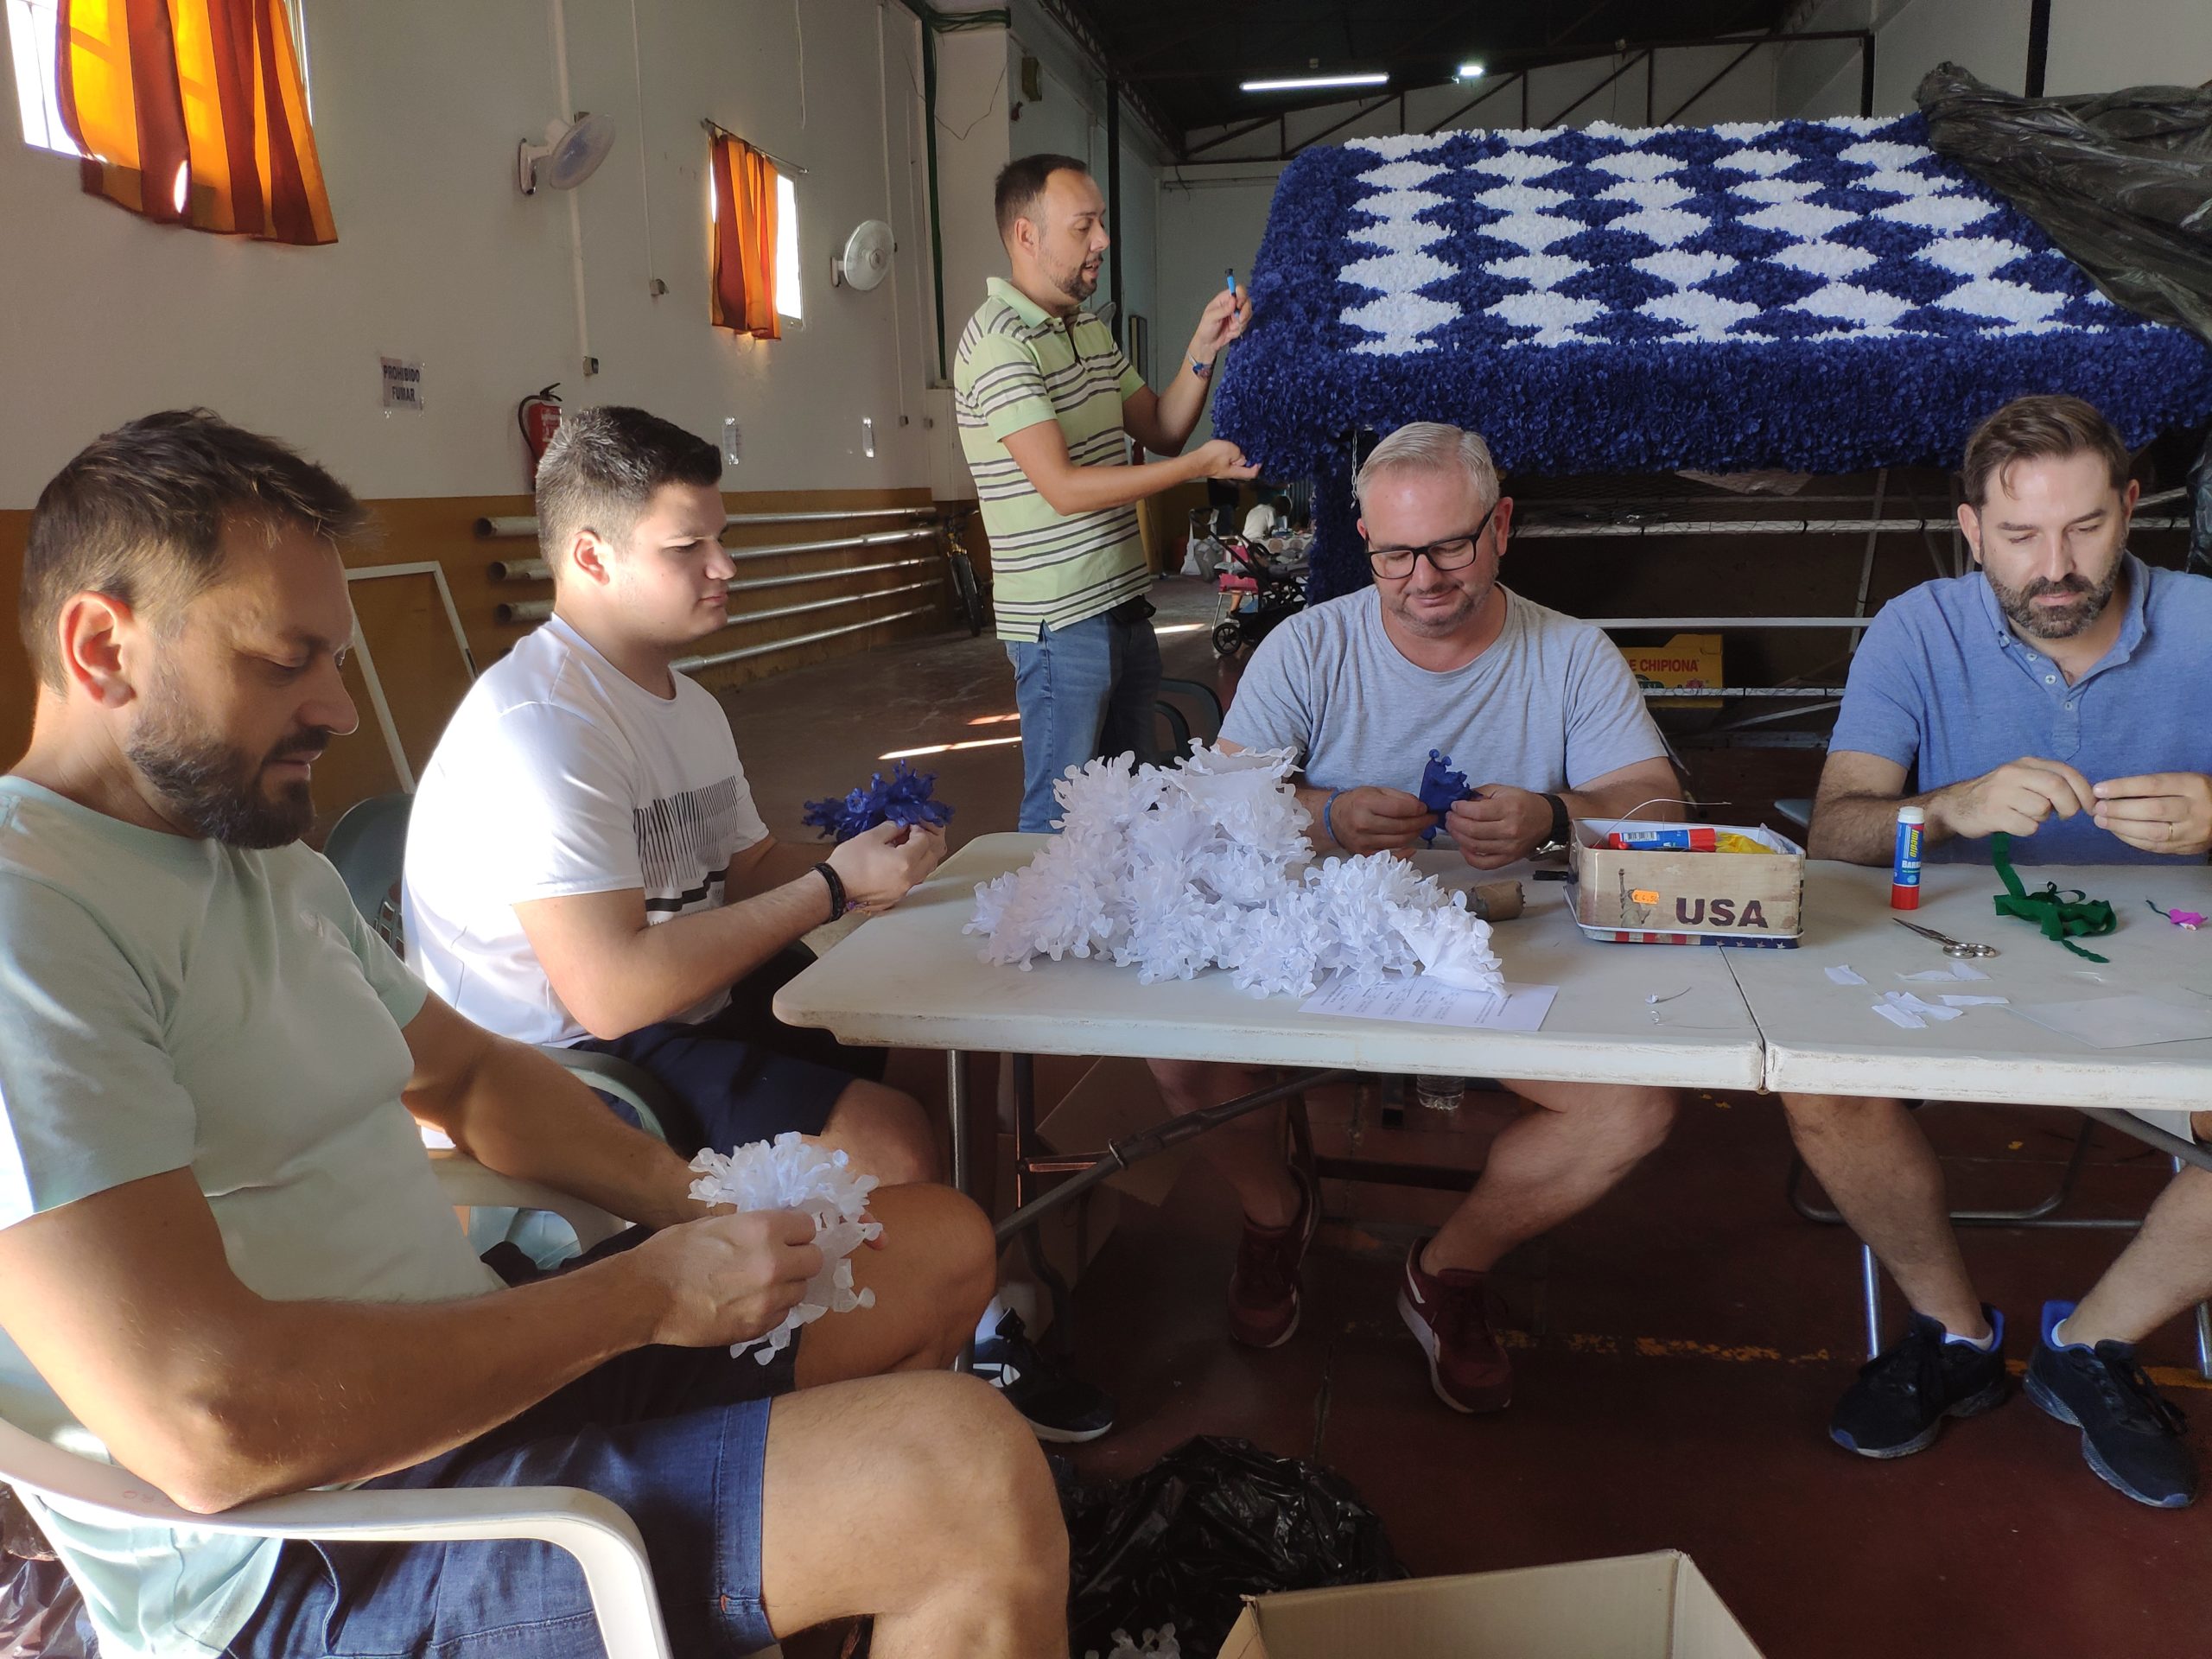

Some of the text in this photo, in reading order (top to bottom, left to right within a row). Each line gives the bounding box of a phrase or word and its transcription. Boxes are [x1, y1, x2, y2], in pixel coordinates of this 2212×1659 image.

[384, 365, 420, 382] PROHIBIDO
[391, 385, 416, 402] FUMAR
[1627, 658, 1698, 672] E CHIPIONA
[1676, 898, 1769, 928] USA
